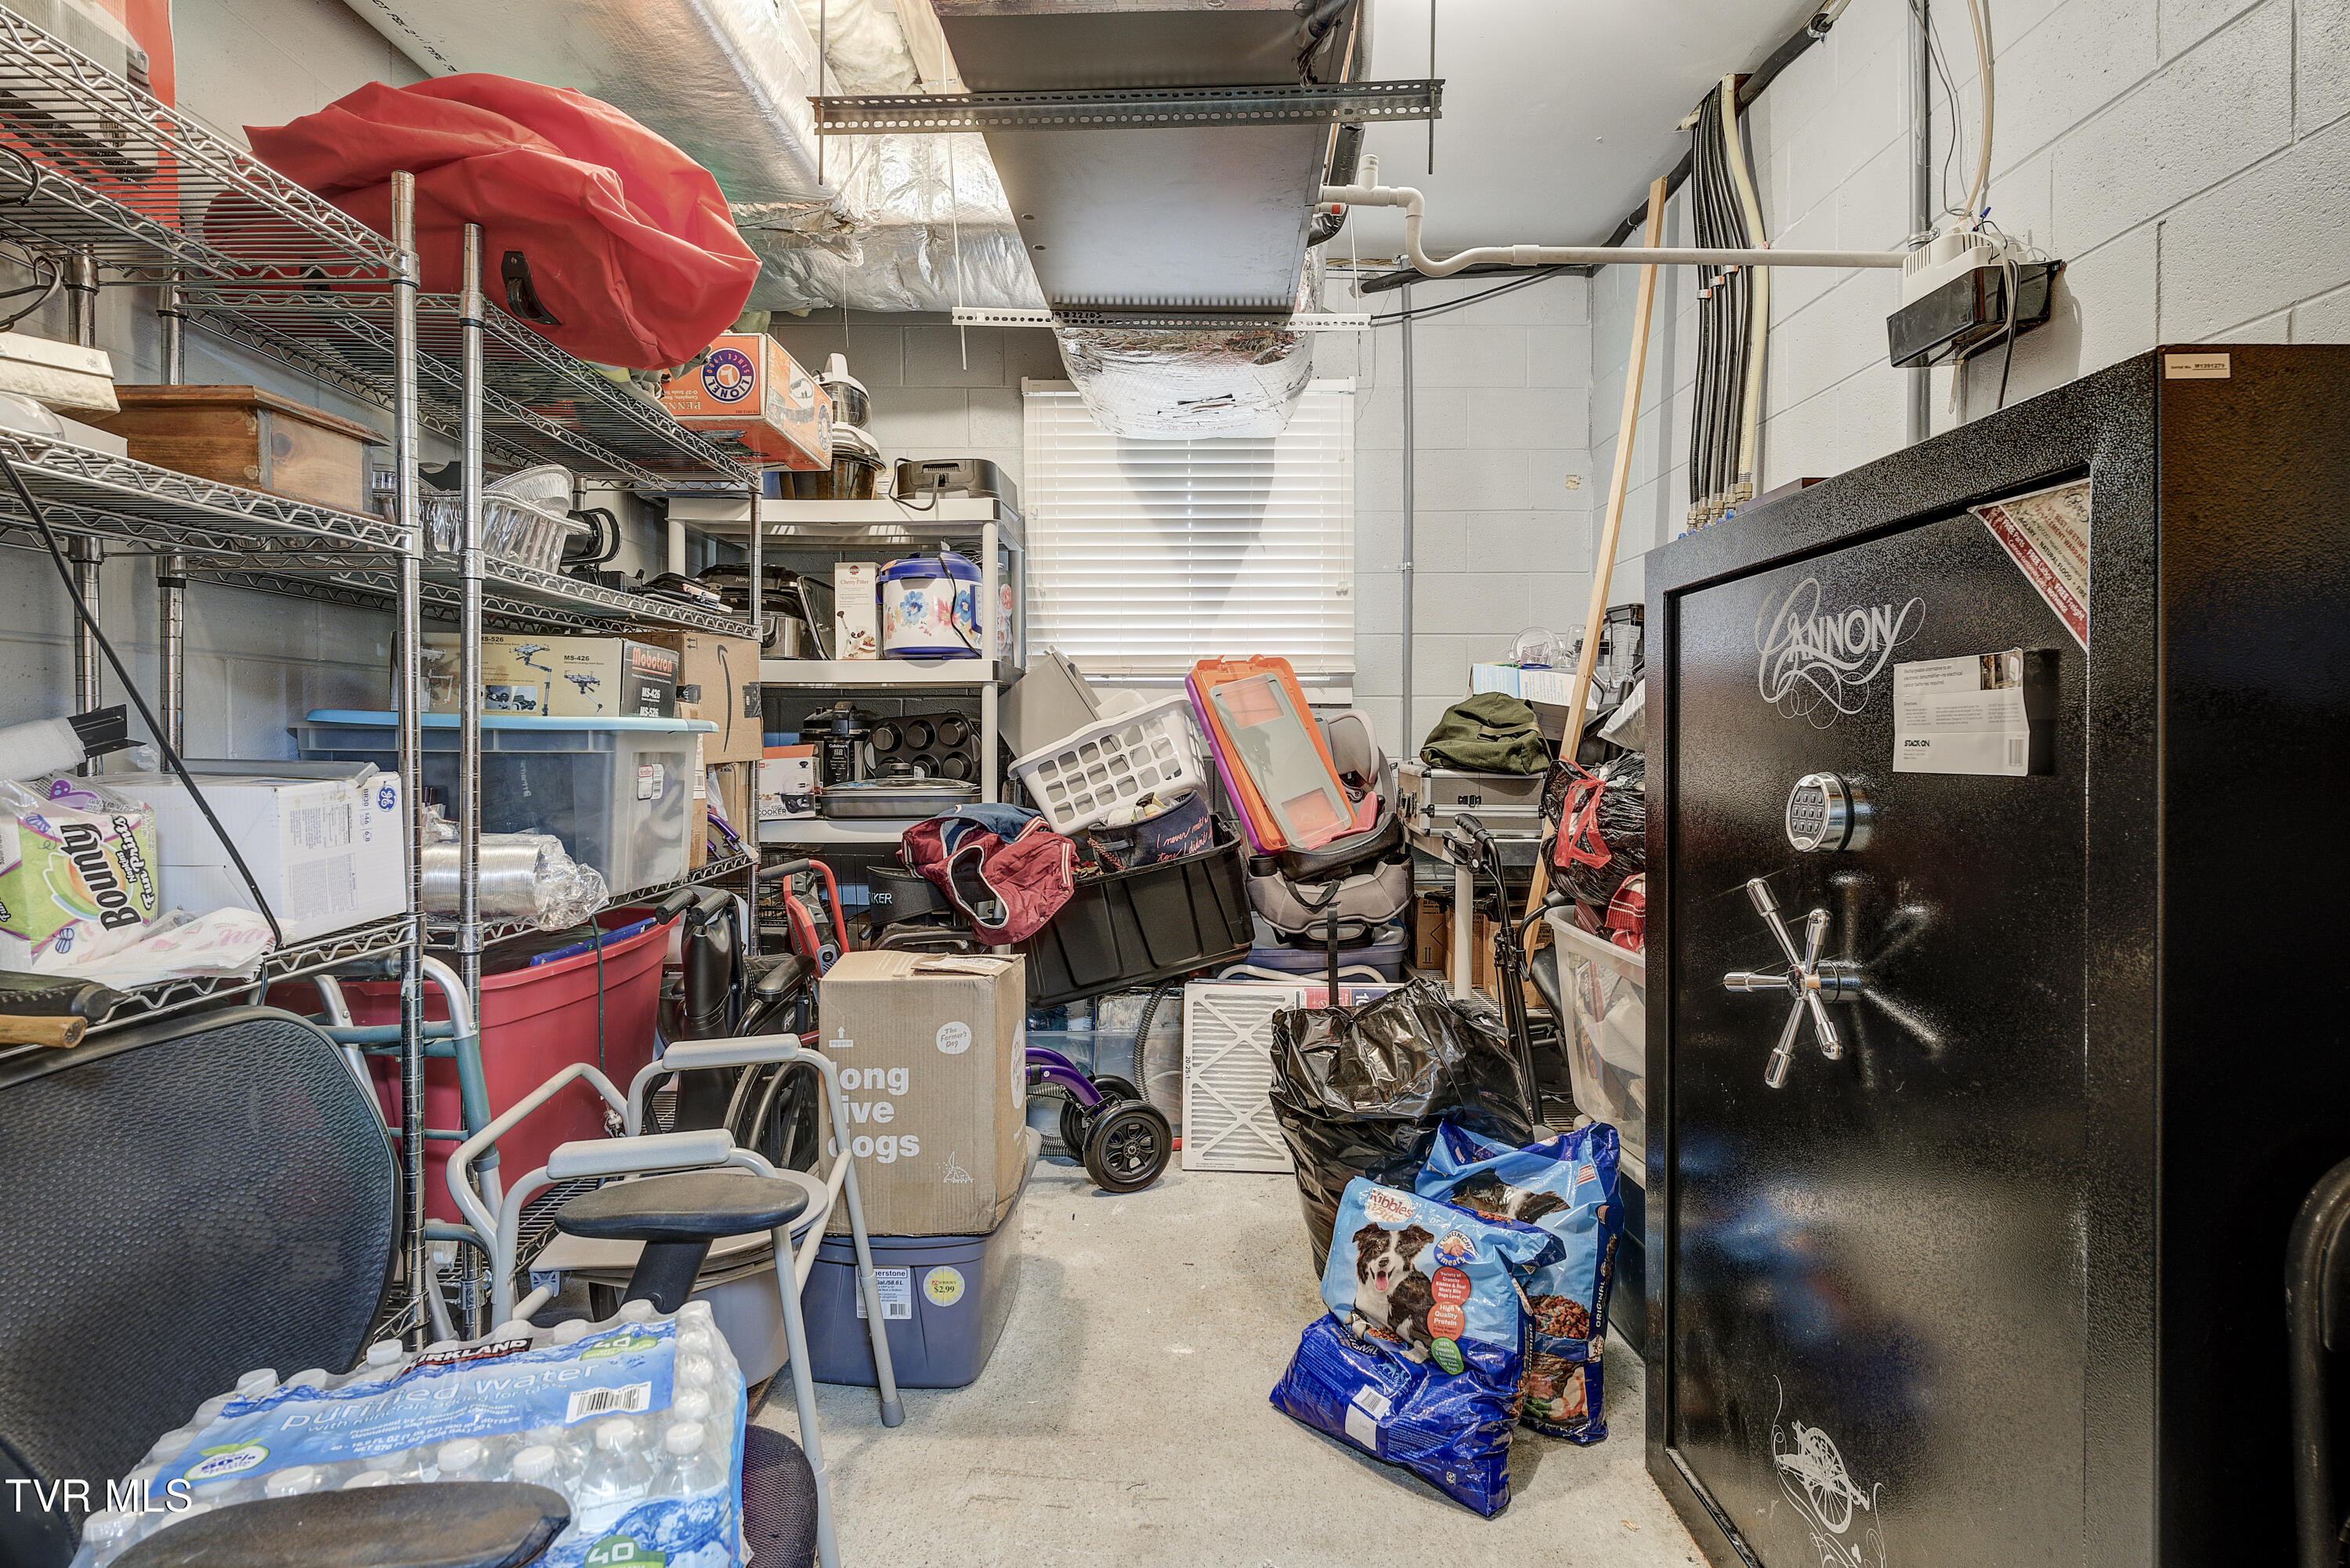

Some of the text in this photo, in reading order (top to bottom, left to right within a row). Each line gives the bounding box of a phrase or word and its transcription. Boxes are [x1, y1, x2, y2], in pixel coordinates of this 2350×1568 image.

[707, 354, 723, 374] 1900
[728, 353, 750, 374] SINCE
[707, 379, 750, 399] LIONEL
[2055, 513, 2066, 529] BEST
[2066, 524, 2088, 552] LIFETIME
[2001, 518, 2016, 537] FREE
[2013, 533, 2026, 548] Parts
[2026, 548, 2041, 568] FREE
[2055, 583, 2069, 602] FREE
[2066, 597, 2085, 621] Freight
[2038, 541, 2088, 598] NATURAL FLOOD FIRE
[1755, 578, 1925, 703] CANNON
[632, 647, 673, 672] Mobotron
[642, 687, 661, 699] MS-426
[639, 706, 660, 717] MS-526
[114, 815, 146, 873] Prints
[1163, 827, 1191, 847] never
[1191, 816, 1204, 833] met
[60, 823, 142, 931] Bounty
[117, 851, 137, 883] Napkins
[139, 871, 155, 910] Fun
[940, 1031, 968, 1042] Farmer's
[829, 1095, 894, 1123] ive
[1369, 1190, 1415, 1218] Kibbles
[1442, 1231, 1474, 1252] CRUNCHY
[1441, 1255, 1466, 1266] meaty
[1434, 1311, 1458, 1320] Quality
[1596, 1281, 1605, 1328] ORIGINAL
[281, 1363, 602, 1432] purified water
[308, 1420, 348, 1433] with
[439, 1393, 489, 1407] added
[494, 1389, 519, 1400] for
[350, 1418, 402, 1435] Processed
[588, 1541, 634, 1565] 40
